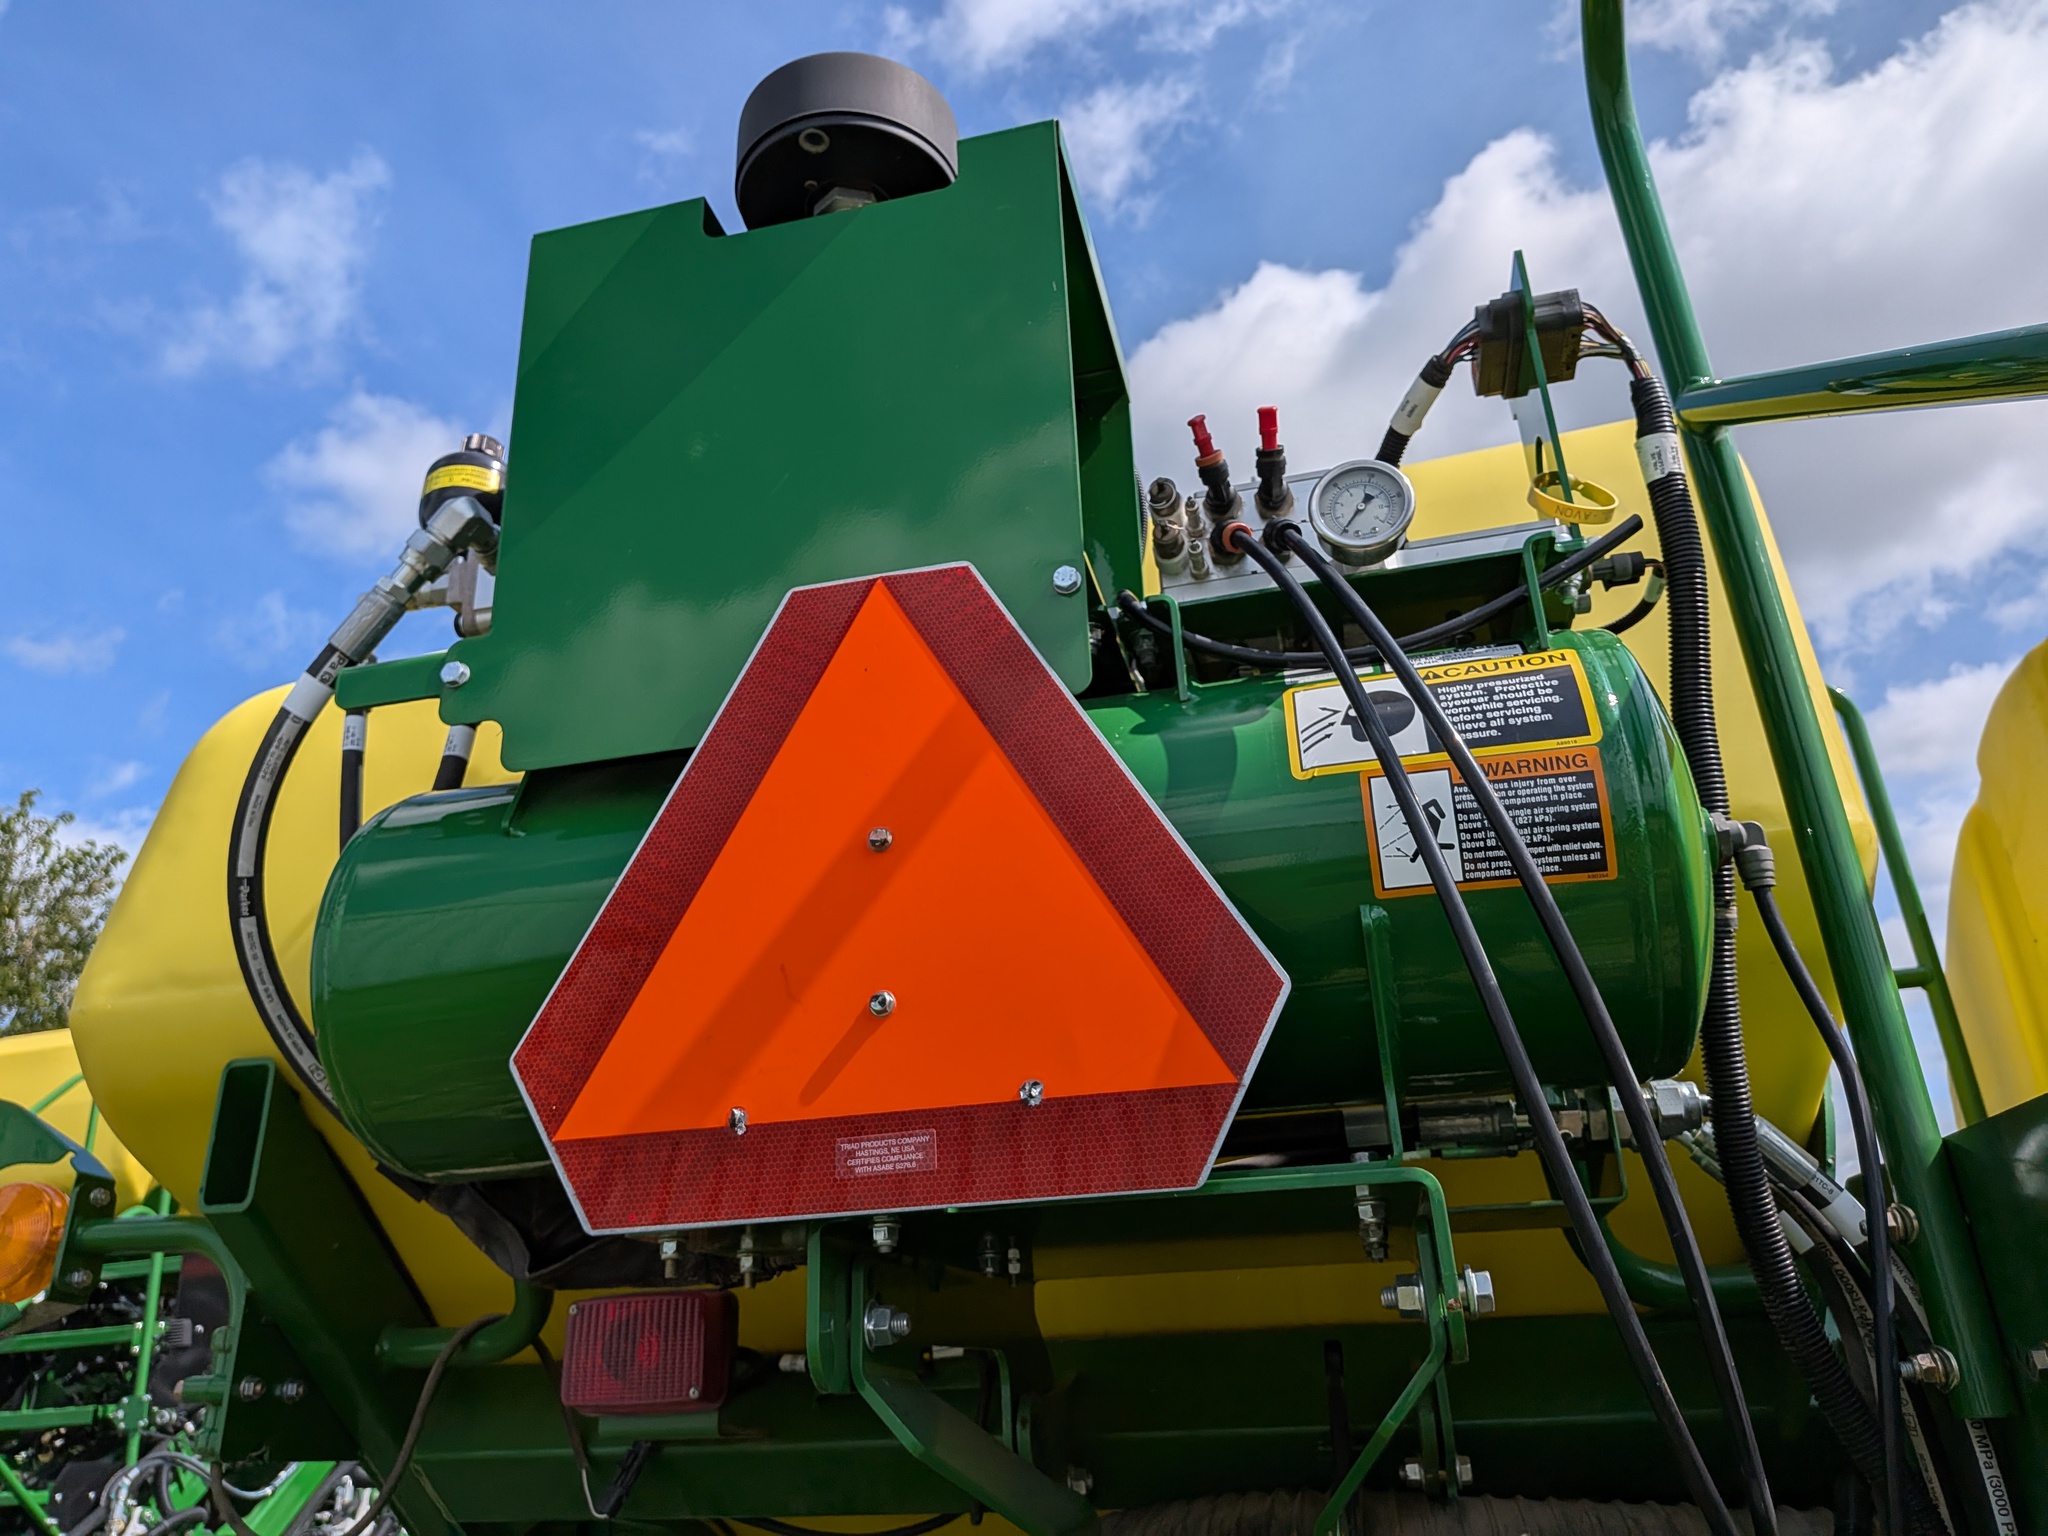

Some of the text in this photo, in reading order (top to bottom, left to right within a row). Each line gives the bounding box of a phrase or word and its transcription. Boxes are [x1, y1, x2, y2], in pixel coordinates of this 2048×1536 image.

[1554, 505, 1592, 520] AVON
[1443, 653, 1567, 678] CAUTION
[1437, 673, 1545, 695] Highly pressurized
[1439, 679, 1559, 701] system. Protective
[1440, 687, 1553, 708] eyewear should be
[1473, 701, 1504, 712] while
[1506, 694, 1564, 708] servicing.
[1486, 705, 1542, 720] servicing
[1489, 718, 1505, 728] all
[1508, 713, 1554, 726] system
[1460, 729, 1502, 740] essure.
[1480, 753, 1589, 777] WARNING
[1453, 785, 1471, 794] Avo
[1510, 779, 1535, 792] injury
[1537, 776, 1557, 786] from
[1558, 775, 1577, 783] over
[1517, 785, 1552, 798] operating
[1553, 783, 1565, 792] the
[1566, 781, 1594, 791] system
[1455, 791, 1586, 810] witho components in place.
[1457, 813, 1468, 821] Do
[1469, 812, 1482, 820] not
[1508, 808, 1532, 819] single
[1533, 806, 1544, 814] air
[1545, 805, 1569, 817] spring
[1570, 803, 1598, 812] system
[1458, 820, 1483, 830] above
[1515, 815, 1533, 826] (827
[1534, 813, 1556, 824] kPa).
[1460, 832, 1471, 840] Do
[1472, 831, 1485, 839] not
[1533, 826, 1544, 834] air
[1545, 824, 1571, 836] spring
[1572, 822, 1600, 832] system
[1461, 840, 1485, 849] above
[1486, 839, 1496, 847] 80
[1532, 834, 1554, 844] kPa).
[1463, 852, 1473, 860] Do
[1474, 850, 1486, 859] not
[1546, 843, 1562, 853] with
[1562, 842, 1581, 851] relief
[1581, 841, 1604, 850] valve.
[1464, 862, 1475, 870] Do
[1476, 861, 1489, 869] not
[1533, 854, 1561, 865] system
[1562, 853, 1588, 862] unless
[1590, 851, 1601, 860] all
[1465, 868, 1512, 880] components
[840, 1135, 930, 1151] TRIAD PRODUCTS COMPANY
[847, 1152, 924, 1166] CERTIFIES COMPLIANCE
[854, 1165, 872, 1174] WITH
[872, 1163, 895, 1172] ASABE
[1974, 1434, 1994, 1470] MPa
[1987, 1474, 2010, 1517] (3000
